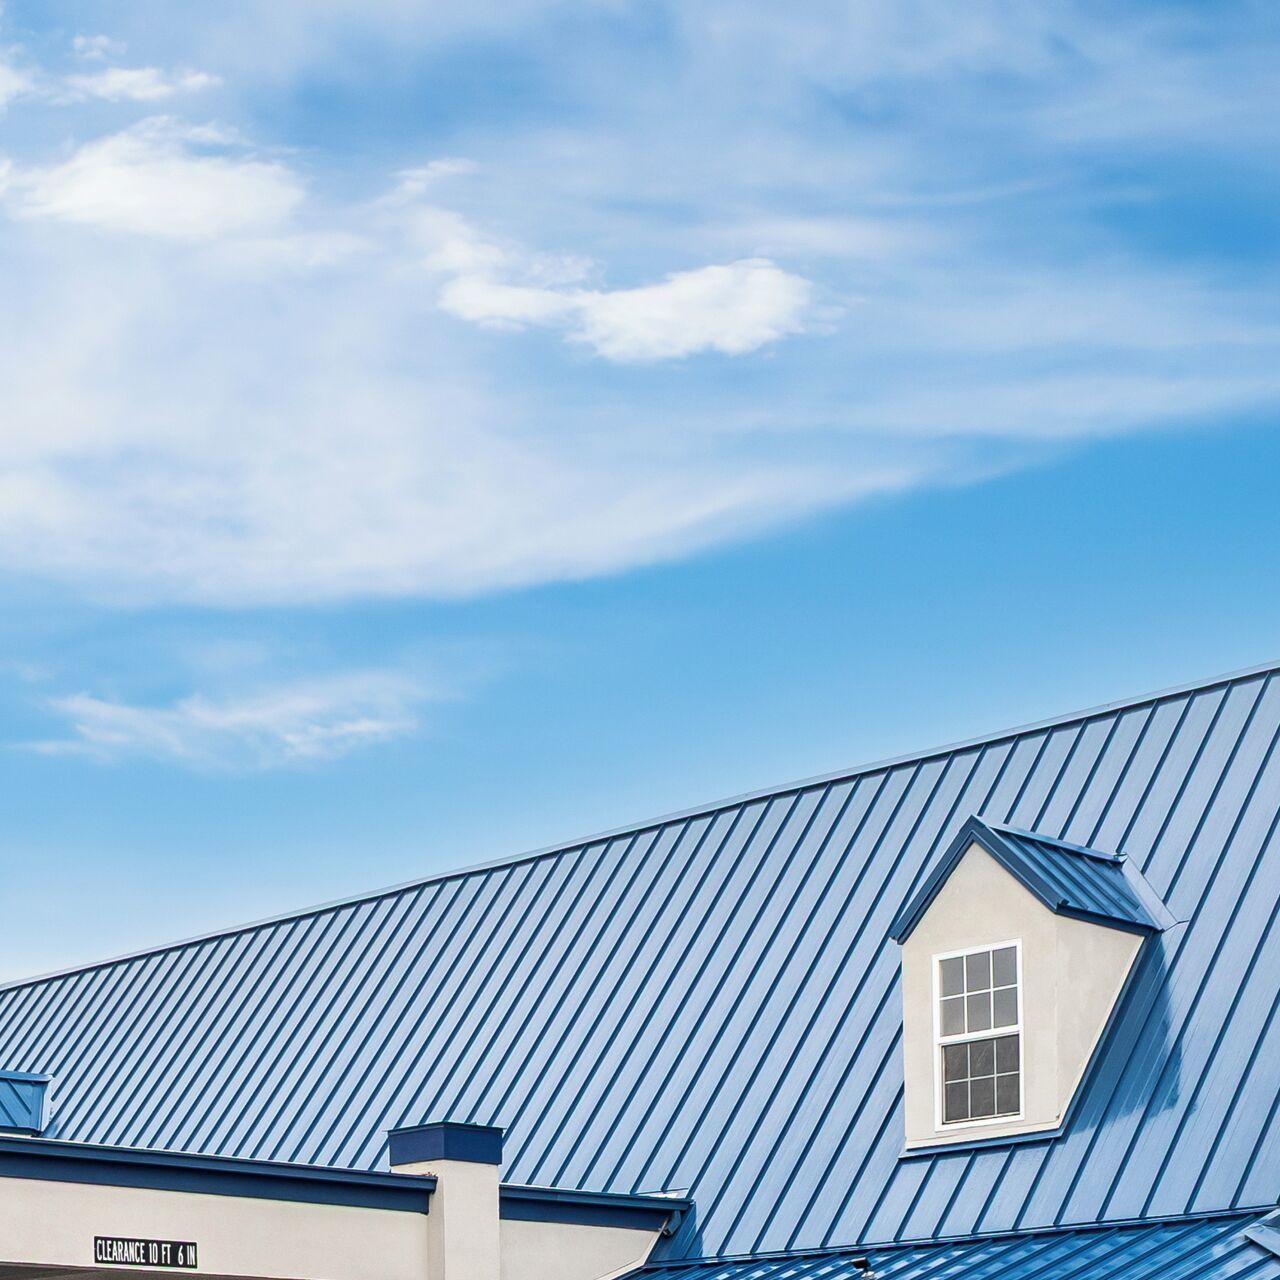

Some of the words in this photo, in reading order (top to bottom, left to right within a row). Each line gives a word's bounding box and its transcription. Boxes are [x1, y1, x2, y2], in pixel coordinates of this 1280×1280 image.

[96, 1239, 145, 1263] CLEARANCE
[148, 1242, 158, 1264] 10
[161, 1243, 171, 1265] FT
[177, 1244, 184, 1266] 6
[186, 1245, 195, 1266] IN
